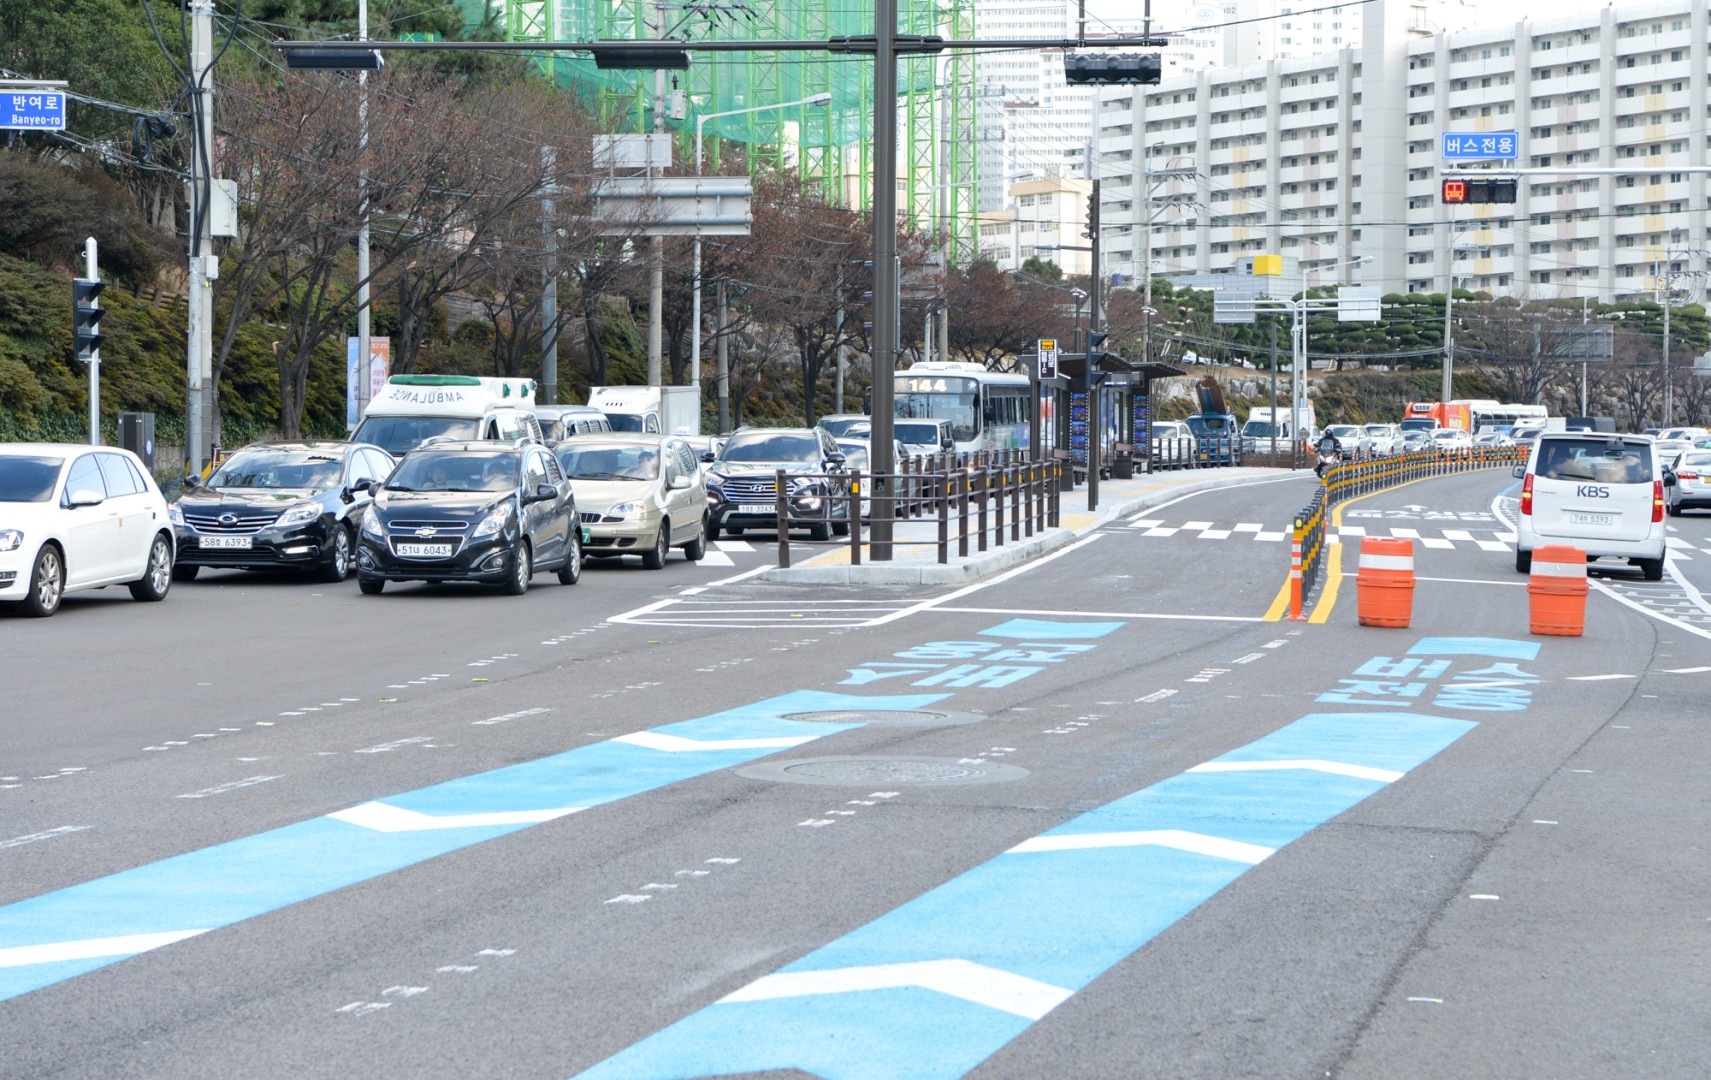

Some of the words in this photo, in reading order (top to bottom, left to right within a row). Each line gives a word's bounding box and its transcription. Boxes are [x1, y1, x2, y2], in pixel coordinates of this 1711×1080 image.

[13, 95, 59, 111] 반여로
[12, 114, 60, 126] Banyeo-ro
[1447, 137, 1513, 154] 버스전용
[909, 379, 947, 392] 144
[1577, 485, 1610, 498] KBS
[225, 538, 247, 547] 6393
[423, 546, 447, 554] 6043
[1352, 656, 1542, 684] 버스
[1314, 679, 1534, 711] 전용
